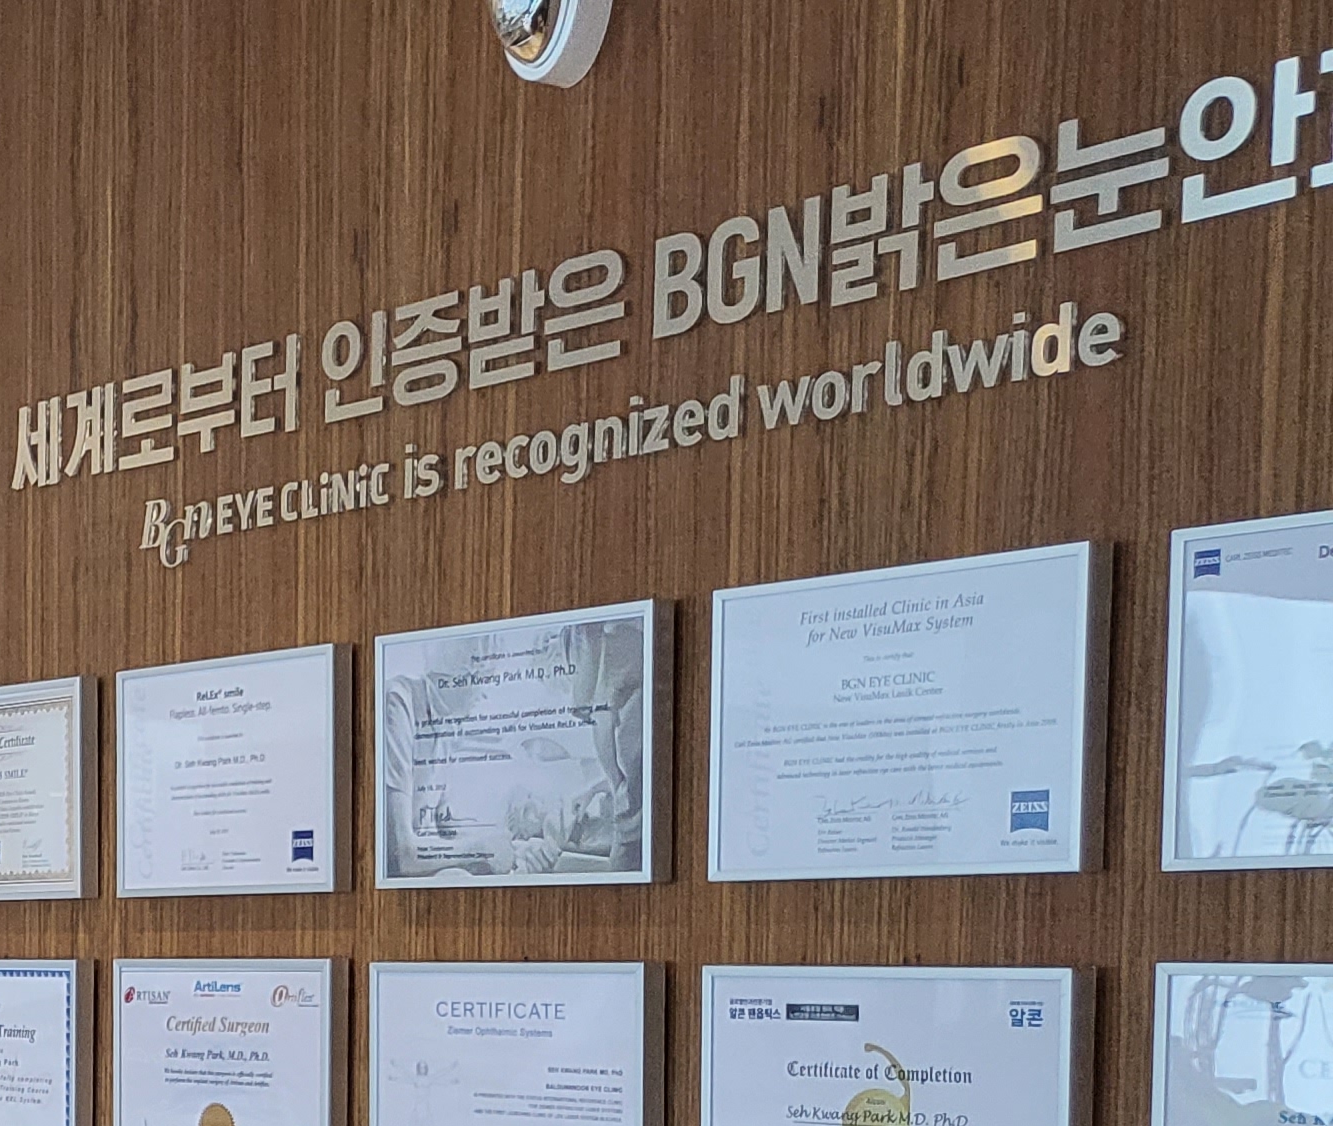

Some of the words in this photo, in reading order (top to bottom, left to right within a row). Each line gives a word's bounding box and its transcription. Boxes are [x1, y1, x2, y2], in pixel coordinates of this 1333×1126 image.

[11, 334, 301, 490] 세계로부터
[321, 249, 625, 424] 인증받은
[652, 50, 1333, 339] BGN밝은눈안
[217, 486, 274, 535] EYE
[403, 444, 441, 499] is
[454, 375, 745, 490] recognized
[757, 302, 1122, 430] worldwide
[800, 610, 830, 626] First
[834, 601, 887, 622] installed
[891, 599, 931, 615] Clinic
[935, 596, 949, 610] in
[952, 591, 984, 609] Asia
[806, 629, 825, 648] for
[829, 627, 858, 643] New
[862, 619, 921, 638] VisuMax
[926, 614, 974, 635] System
[503, 670, 522, 683] Park
[841, 677, 866, 691] BGN
[869, 675, 891, 689] EYE
[893, 671, 936, 686] CLINIC
[1012, 801, 1048, 813] ZEISS
[193, 980, 242, 993] ArtiLens
[435, 1000, 566, 1021] CERTIFICATE
[1009, 1008, 1044, 1027] 알콘
[166, 1015, 217, 1036] Certified
[218, 1016, 270, 1037] Surgeon
[787, 1061, 861, 1079] Certificate
[865, 1063, 879, 1080] of
[884, 1064, 973, 1085] Completion
[786, 1105, 811, 1119] Seh
[812, 1106, 863, 1126] Kwang
[863, 1109, 898, 1123] Park
